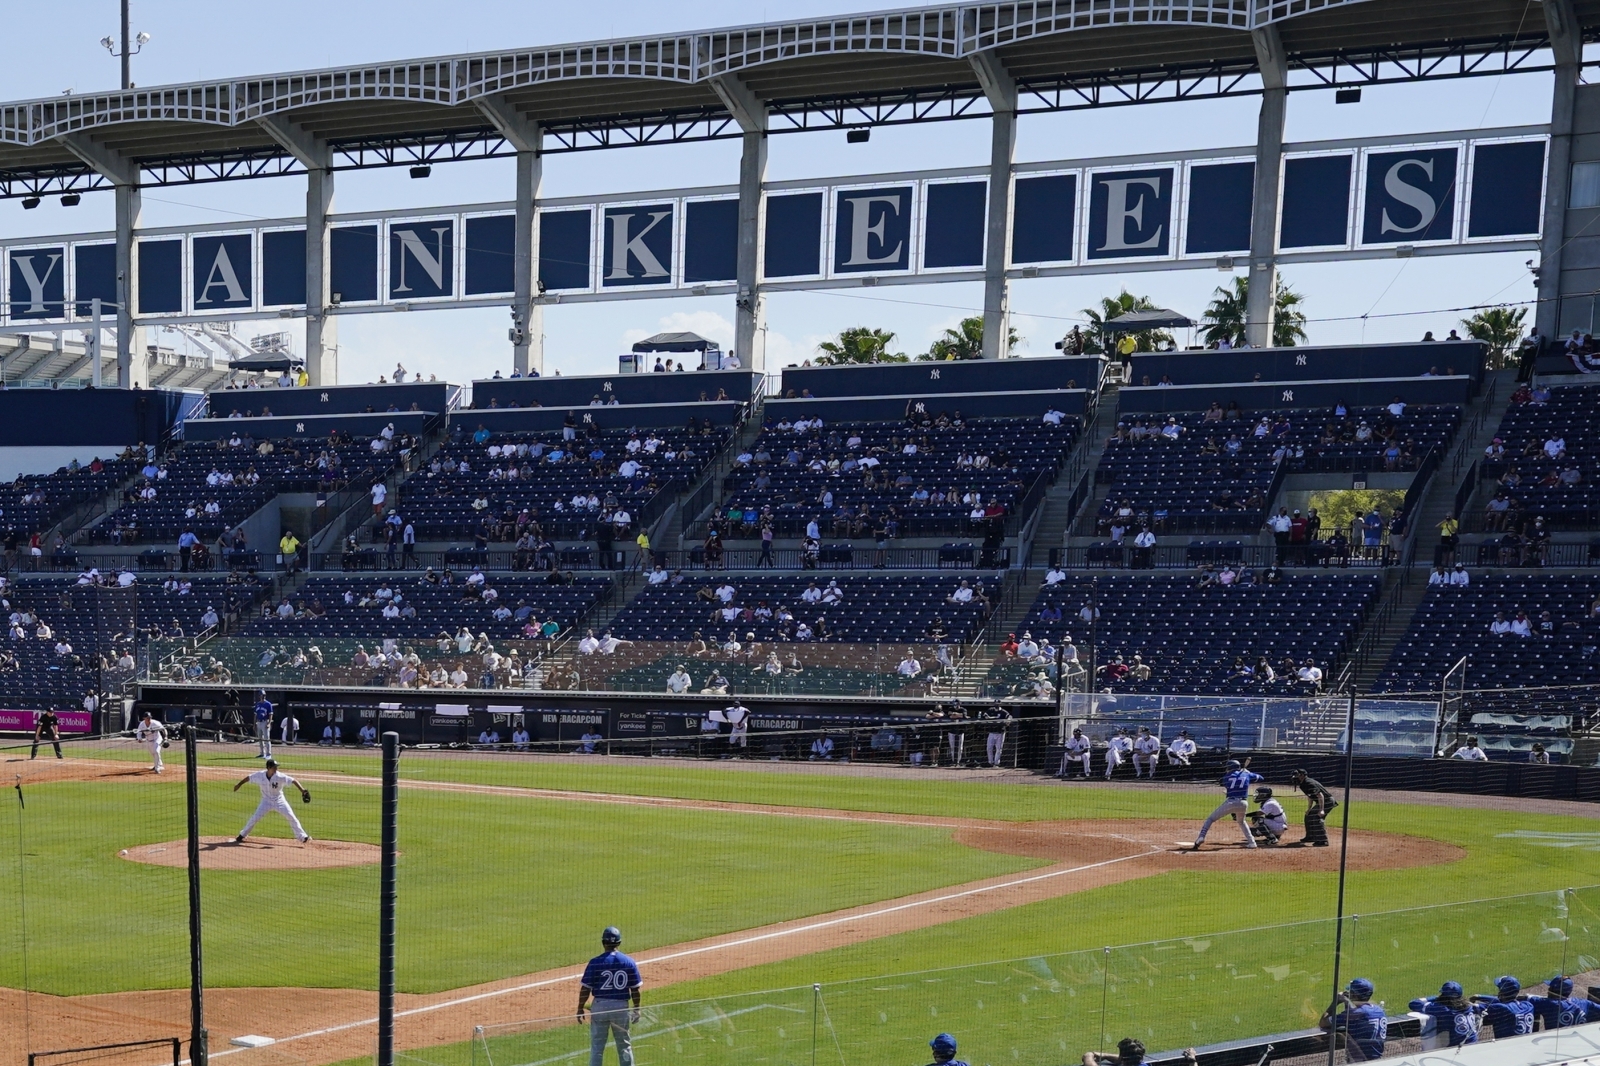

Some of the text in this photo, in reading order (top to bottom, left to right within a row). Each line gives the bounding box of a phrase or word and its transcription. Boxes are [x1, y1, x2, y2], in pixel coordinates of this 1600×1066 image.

[11, 157, 1436, 313] YANKEES
[1228, 776, 1247, 789] 77
[600, 969, 628, 990] 20
[1368, 1016, 1388, 1041] 78
[1515, 1012, 1535, 1035] 59
